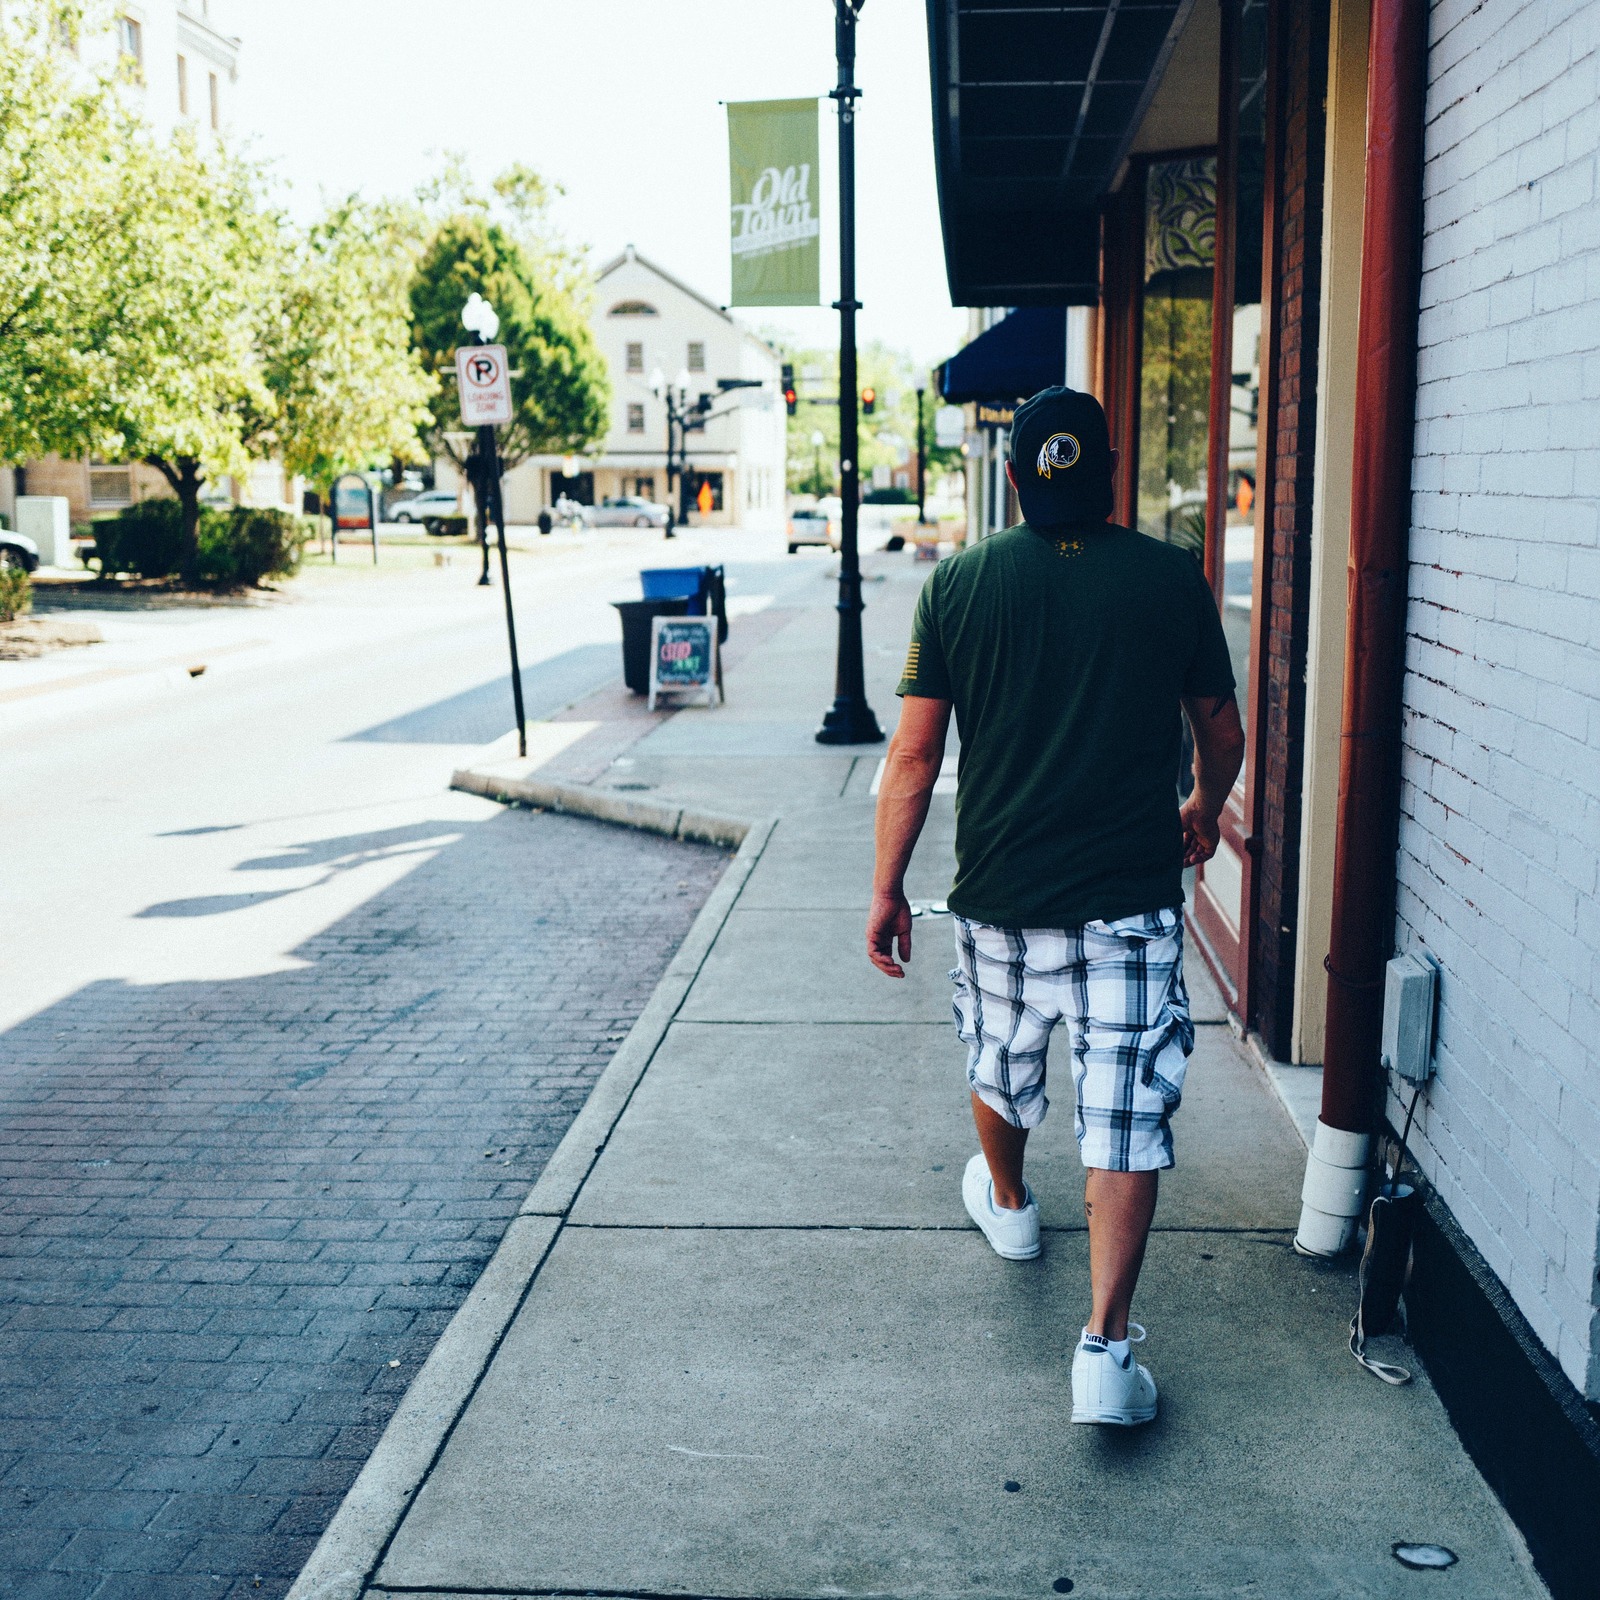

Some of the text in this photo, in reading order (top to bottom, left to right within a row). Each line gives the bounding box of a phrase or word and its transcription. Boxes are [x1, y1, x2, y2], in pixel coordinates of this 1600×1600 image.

[752, 163, 809, 208] Old
[731, 202, 811, 235] Town
[475, 360, 492, 381] P
[467, 391, 504, 402] LOADING
[476, 402, 496, 413] ZONE
[1086, 1334, 1109, 1347] PUMA
